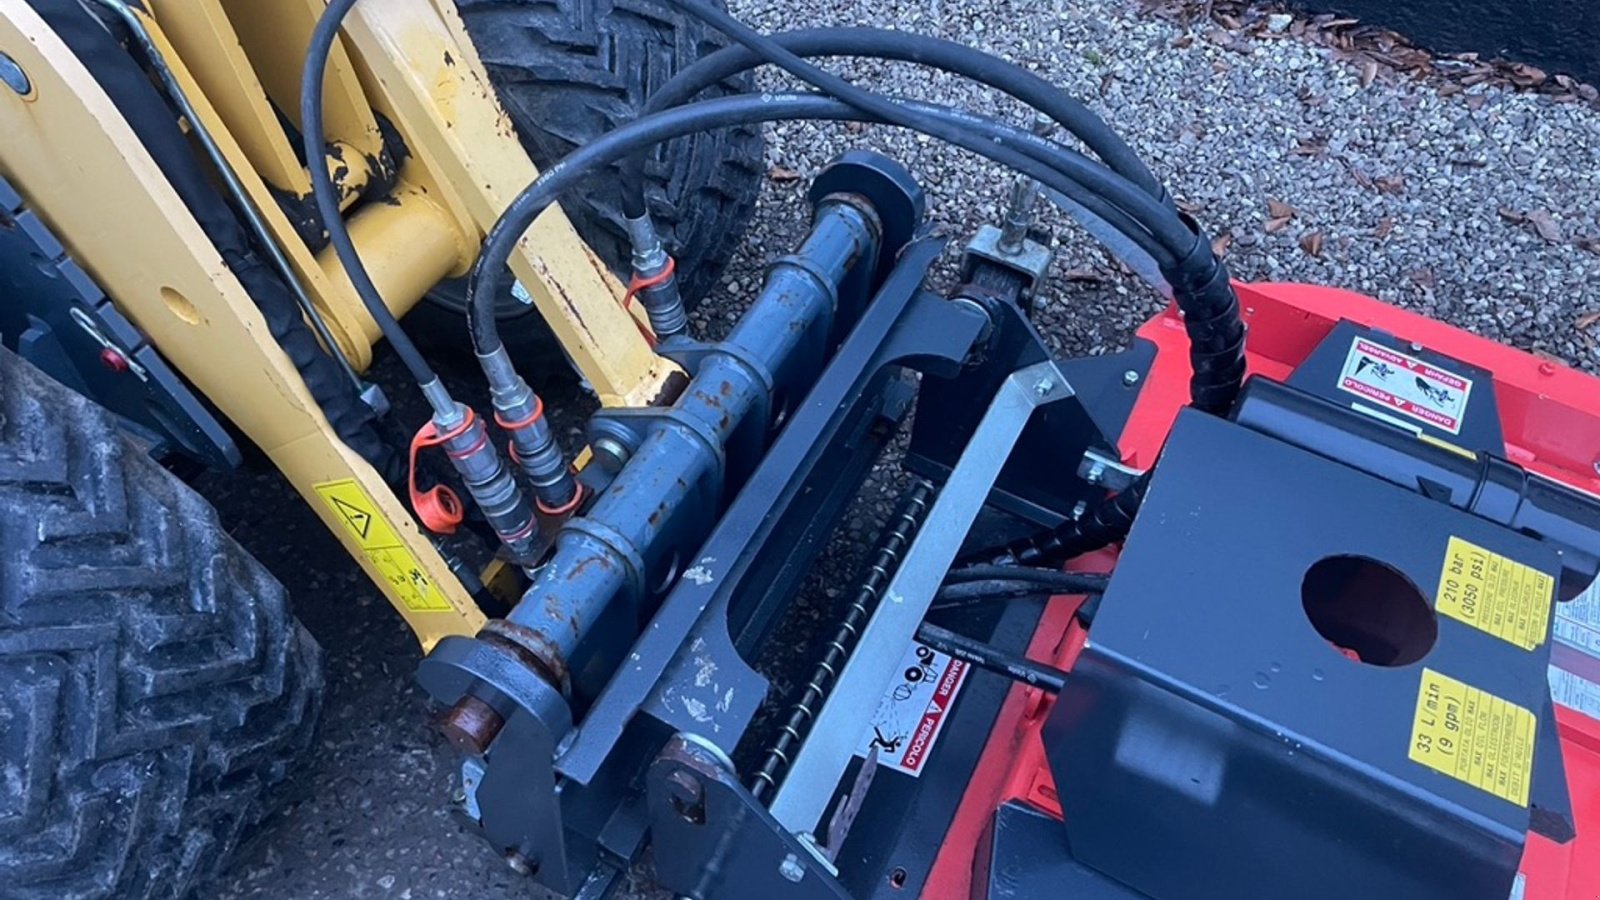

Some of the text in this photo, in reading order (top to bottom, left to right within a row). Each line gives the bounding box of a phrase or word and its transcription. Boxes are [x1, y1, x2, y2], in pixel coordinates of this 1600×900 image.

[1358, 342, 1462, 387] GEFAHR ADVARSEL
[1344, 378, 1451, 425] DANGER PERICOLO
[1444, 553, 1464, 602] 210 bar
[1460, 551, 1487, 619] (3050 psi)
[1498, 568, 1508, 597] PRESSURE
[939, 660, 962, 695] DANGER
[1417, 682, 1440, 753] 33 L/min
[1438, 696, 1462, 755] (9 gpm)
[1464, 714, 1473, 737] OLIO
[906, 718, 934, 765] PERICOLO
[1459, 737, 1470, 772] PORTATA
[1476, 733, 1484, 748] OIL
[1474, 751, 1482, 766] MAX
[1486, 762, 1494, 778] MAX
[1498, 770, 1506, 786] MAX
[1510, 771, 1520, 796] DEBIT
